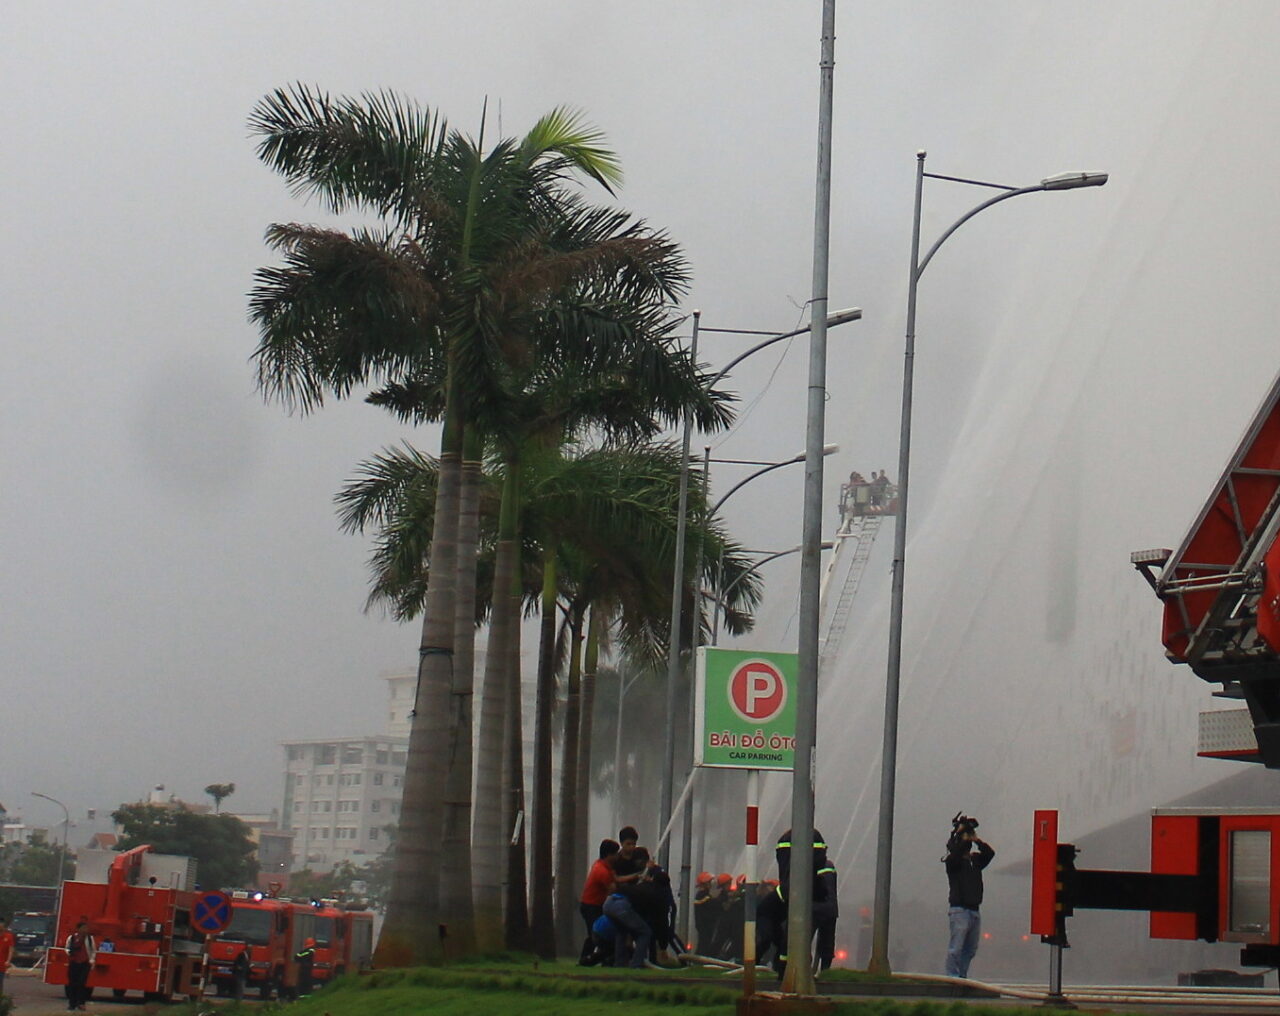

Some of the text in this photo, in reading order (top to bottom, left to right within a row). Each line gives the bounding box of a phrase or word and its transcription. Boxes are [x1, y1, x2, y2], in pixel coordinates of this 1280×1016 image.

[746, 671, 777, 713] P
[710, 730, 736, 747] BÃI
[729, 751, 783, 761] CAR PARKING
